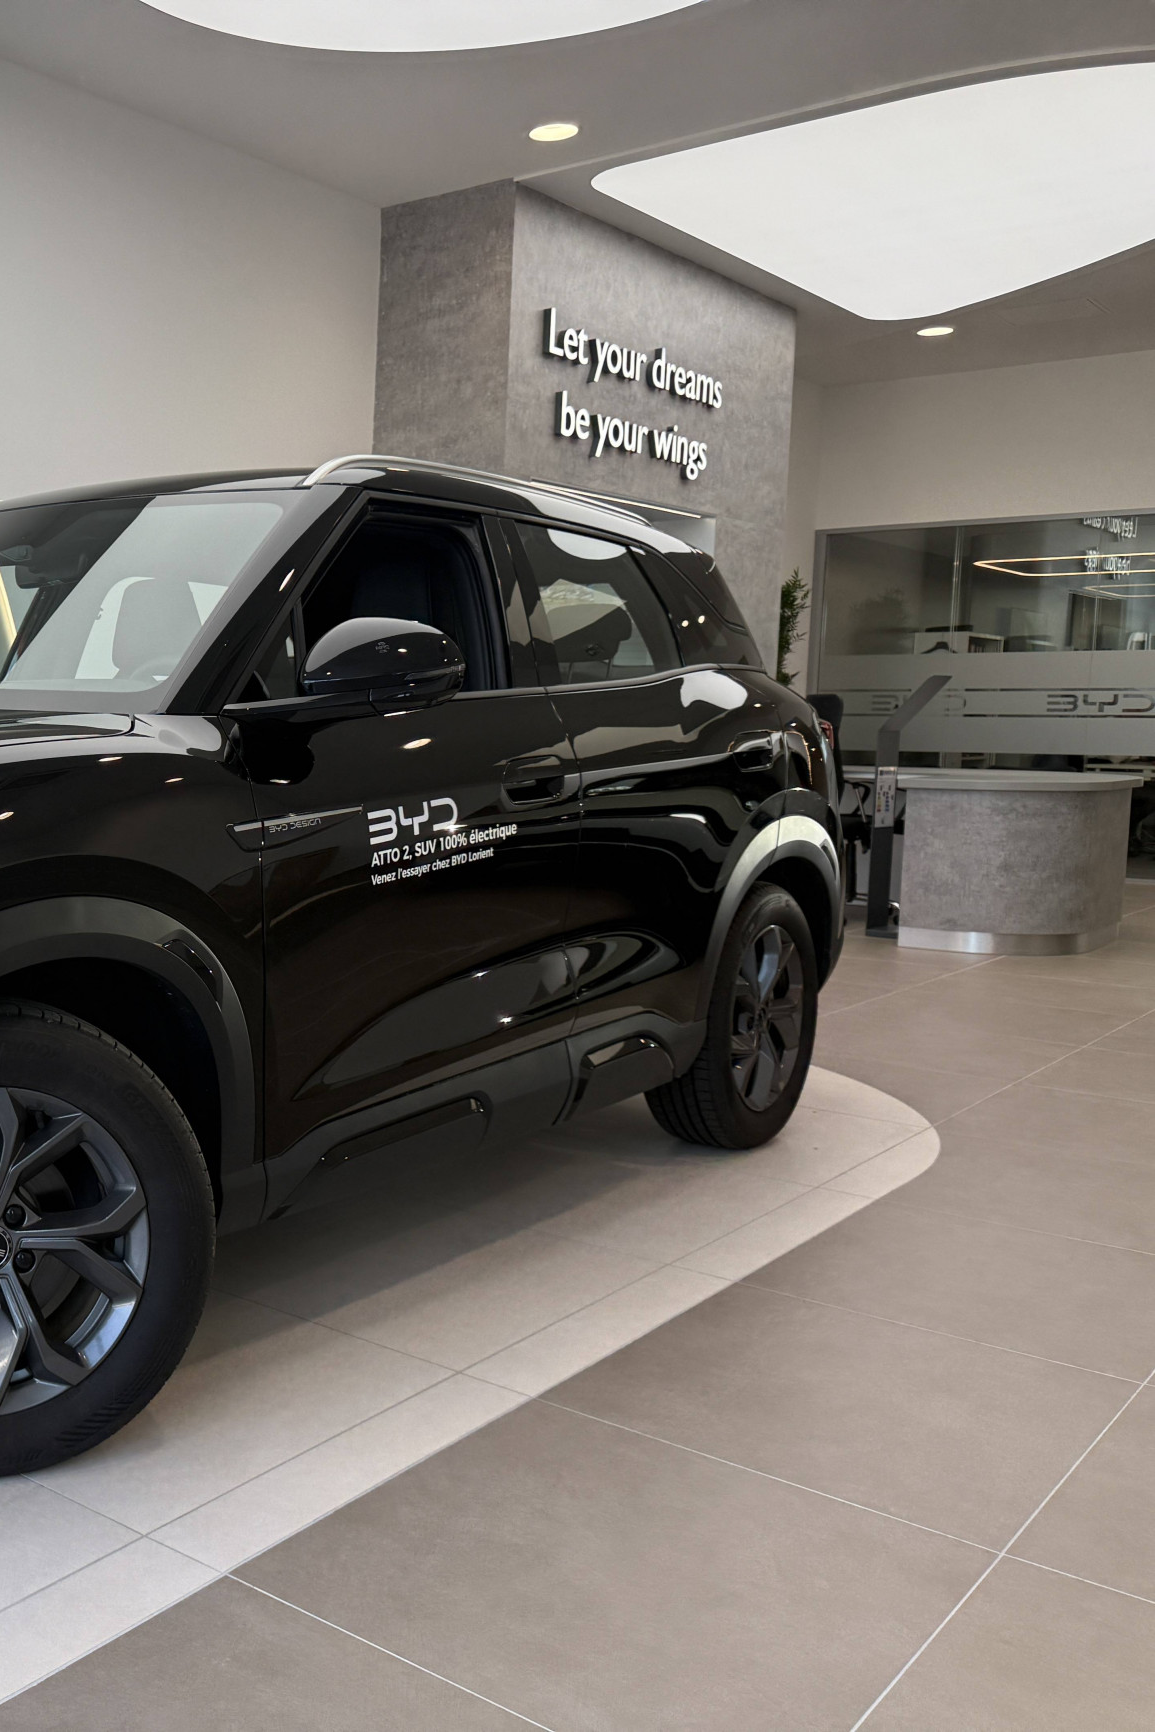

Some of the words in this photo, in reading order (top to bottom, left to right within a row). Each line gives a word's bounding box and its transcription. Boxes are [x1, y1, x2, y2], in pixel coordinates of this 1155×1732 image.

[545, 307, 588, 364] Let
[593, 338, 647, 382] your
[651, 347, 723, 409] dreams
[557, 390, 590, 439] be
[594, 413, 649, 457] your
[653, 425, 708, 480] wings
[1047, 694, 1155, 712] BYD
[269, 824, 288, 833] BYD
[290, 817, 321, 830] DESIGN
[367, 797, 458, 845] BYD
[371, 847, 400, 867] ATTO
[402, 845, 412, 860] 2,
[414, 839, 437, 857] SUV
[439, 832, 468, 851] 100%
[469, 824, 518, 844] électrique
[371, 872, 396, 886] Venez
[398, 863, 431, 879] l'essayer
[432, 858, 450, 871] chez
[451, 853, 468, 867] BYD
[468, 847, 494, 862] Lorient
